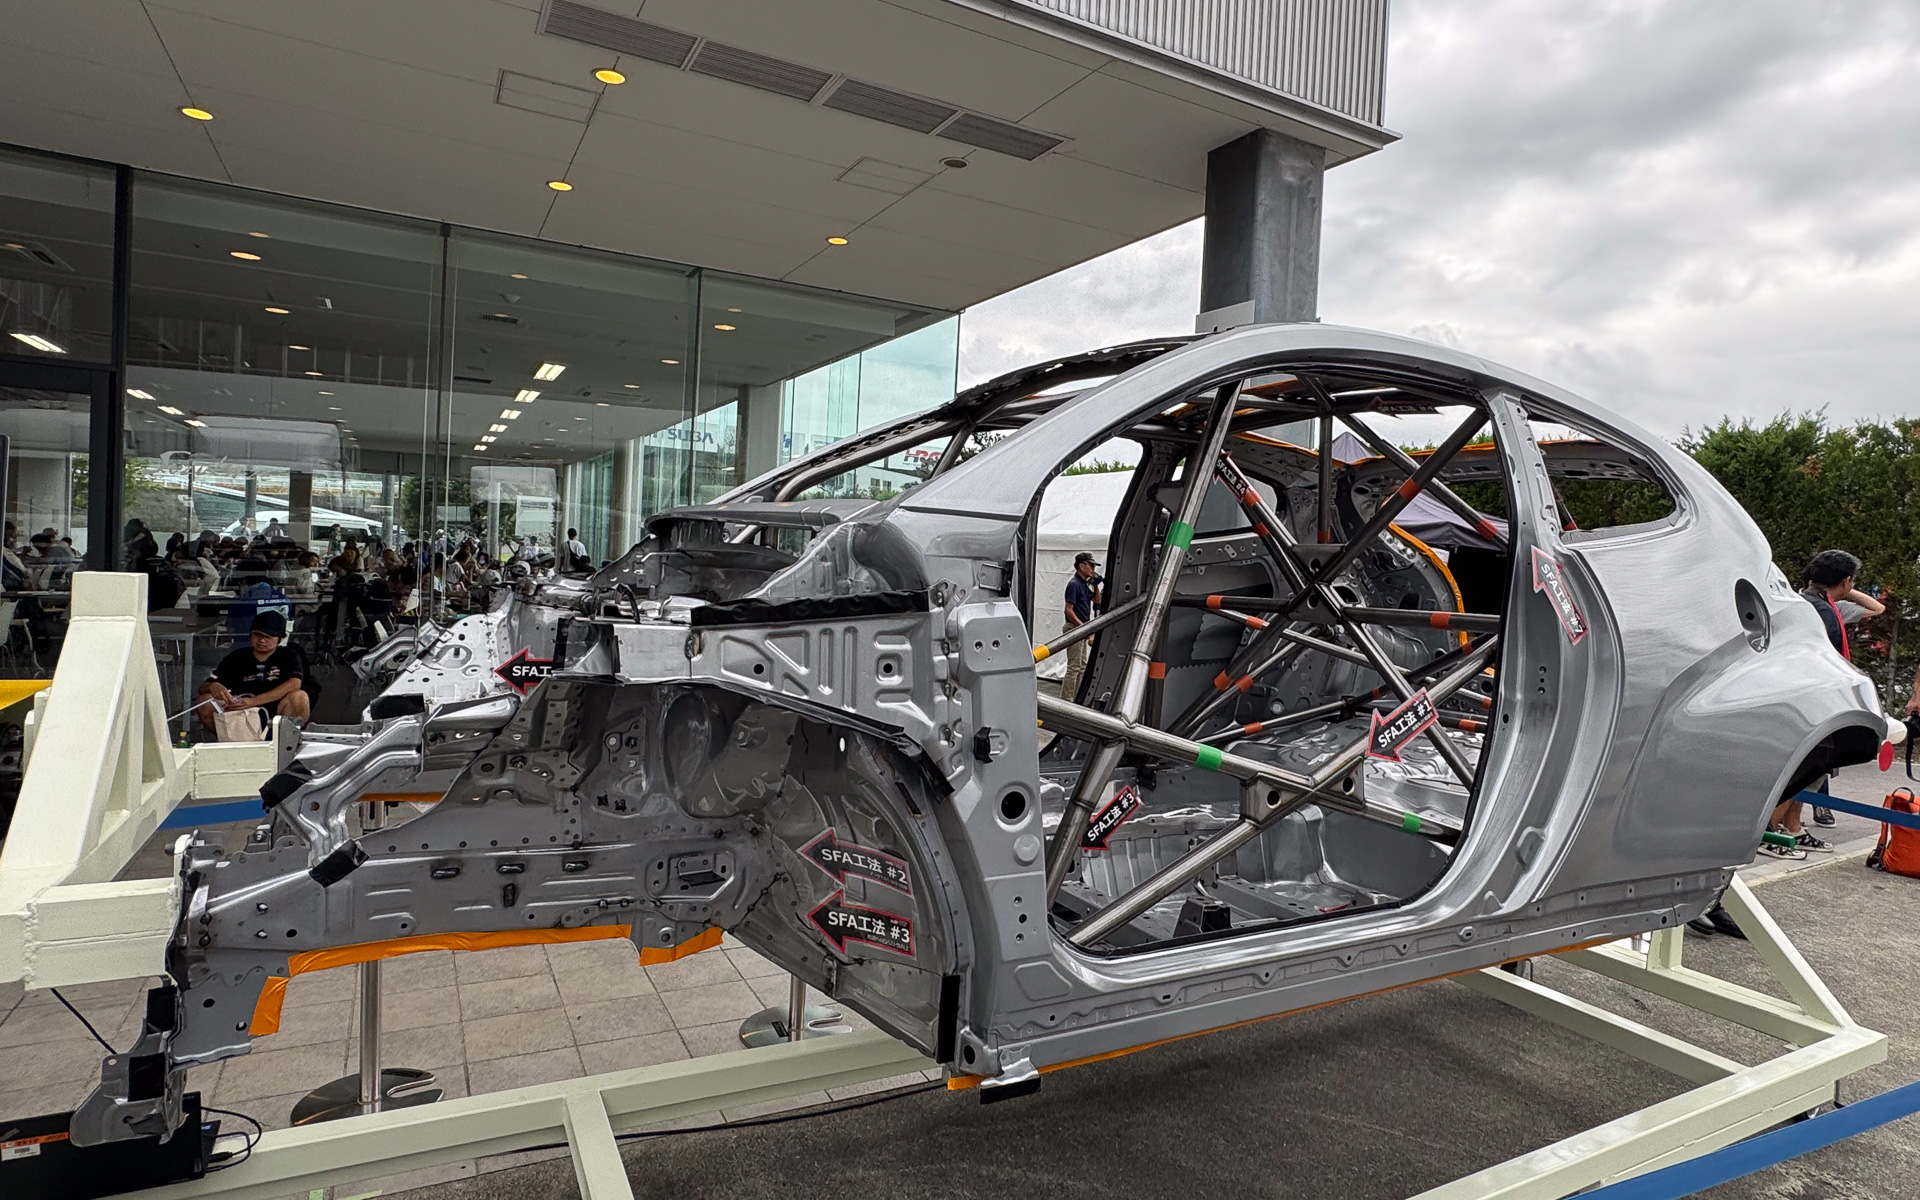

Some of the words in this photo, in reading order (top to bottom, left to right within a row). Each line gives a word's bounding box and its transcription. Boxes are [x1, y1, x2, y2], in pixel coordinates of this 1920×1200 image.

[1541, 563, 1572, 614] SFA工法
[1569, 615, 1584, 634] #7
[1378, 711, 1417, 748] SFA工法
[1416, 700, 1432, 717] #1
[1087, 805, 1122, 842] SFA工法
[1121, 793, 1135, 809] #3
[821, 848, 883, 874] SFA工法
[886, 866, 908, 884] #2
[828, 911, 886, 937] SFA工法
[890, 925, 910, 943] #3
